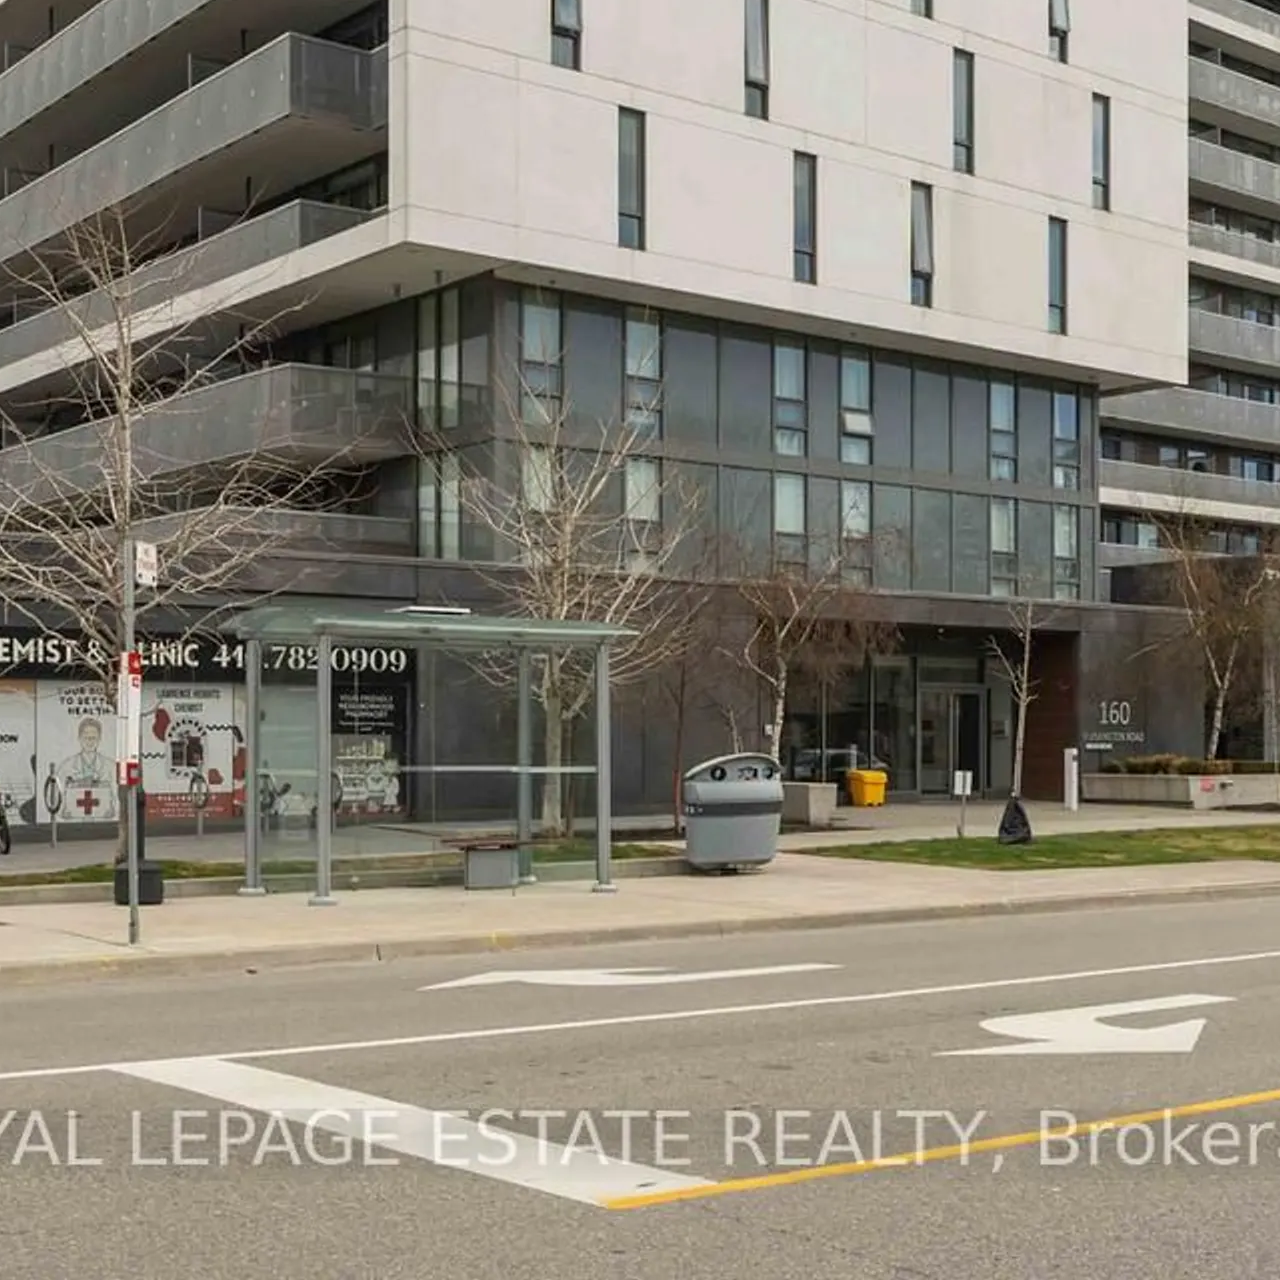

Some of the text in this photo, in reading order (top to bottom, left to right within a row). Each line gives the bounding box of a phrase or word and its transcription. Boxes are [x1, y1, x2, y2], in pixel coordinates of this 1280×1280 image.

[87, 639, 106, 664] &
[137, 641, 199, 667] LINIC
[212, 643, 408, 671] 41.7820909
[1100, 702, 1131, 725] 160
